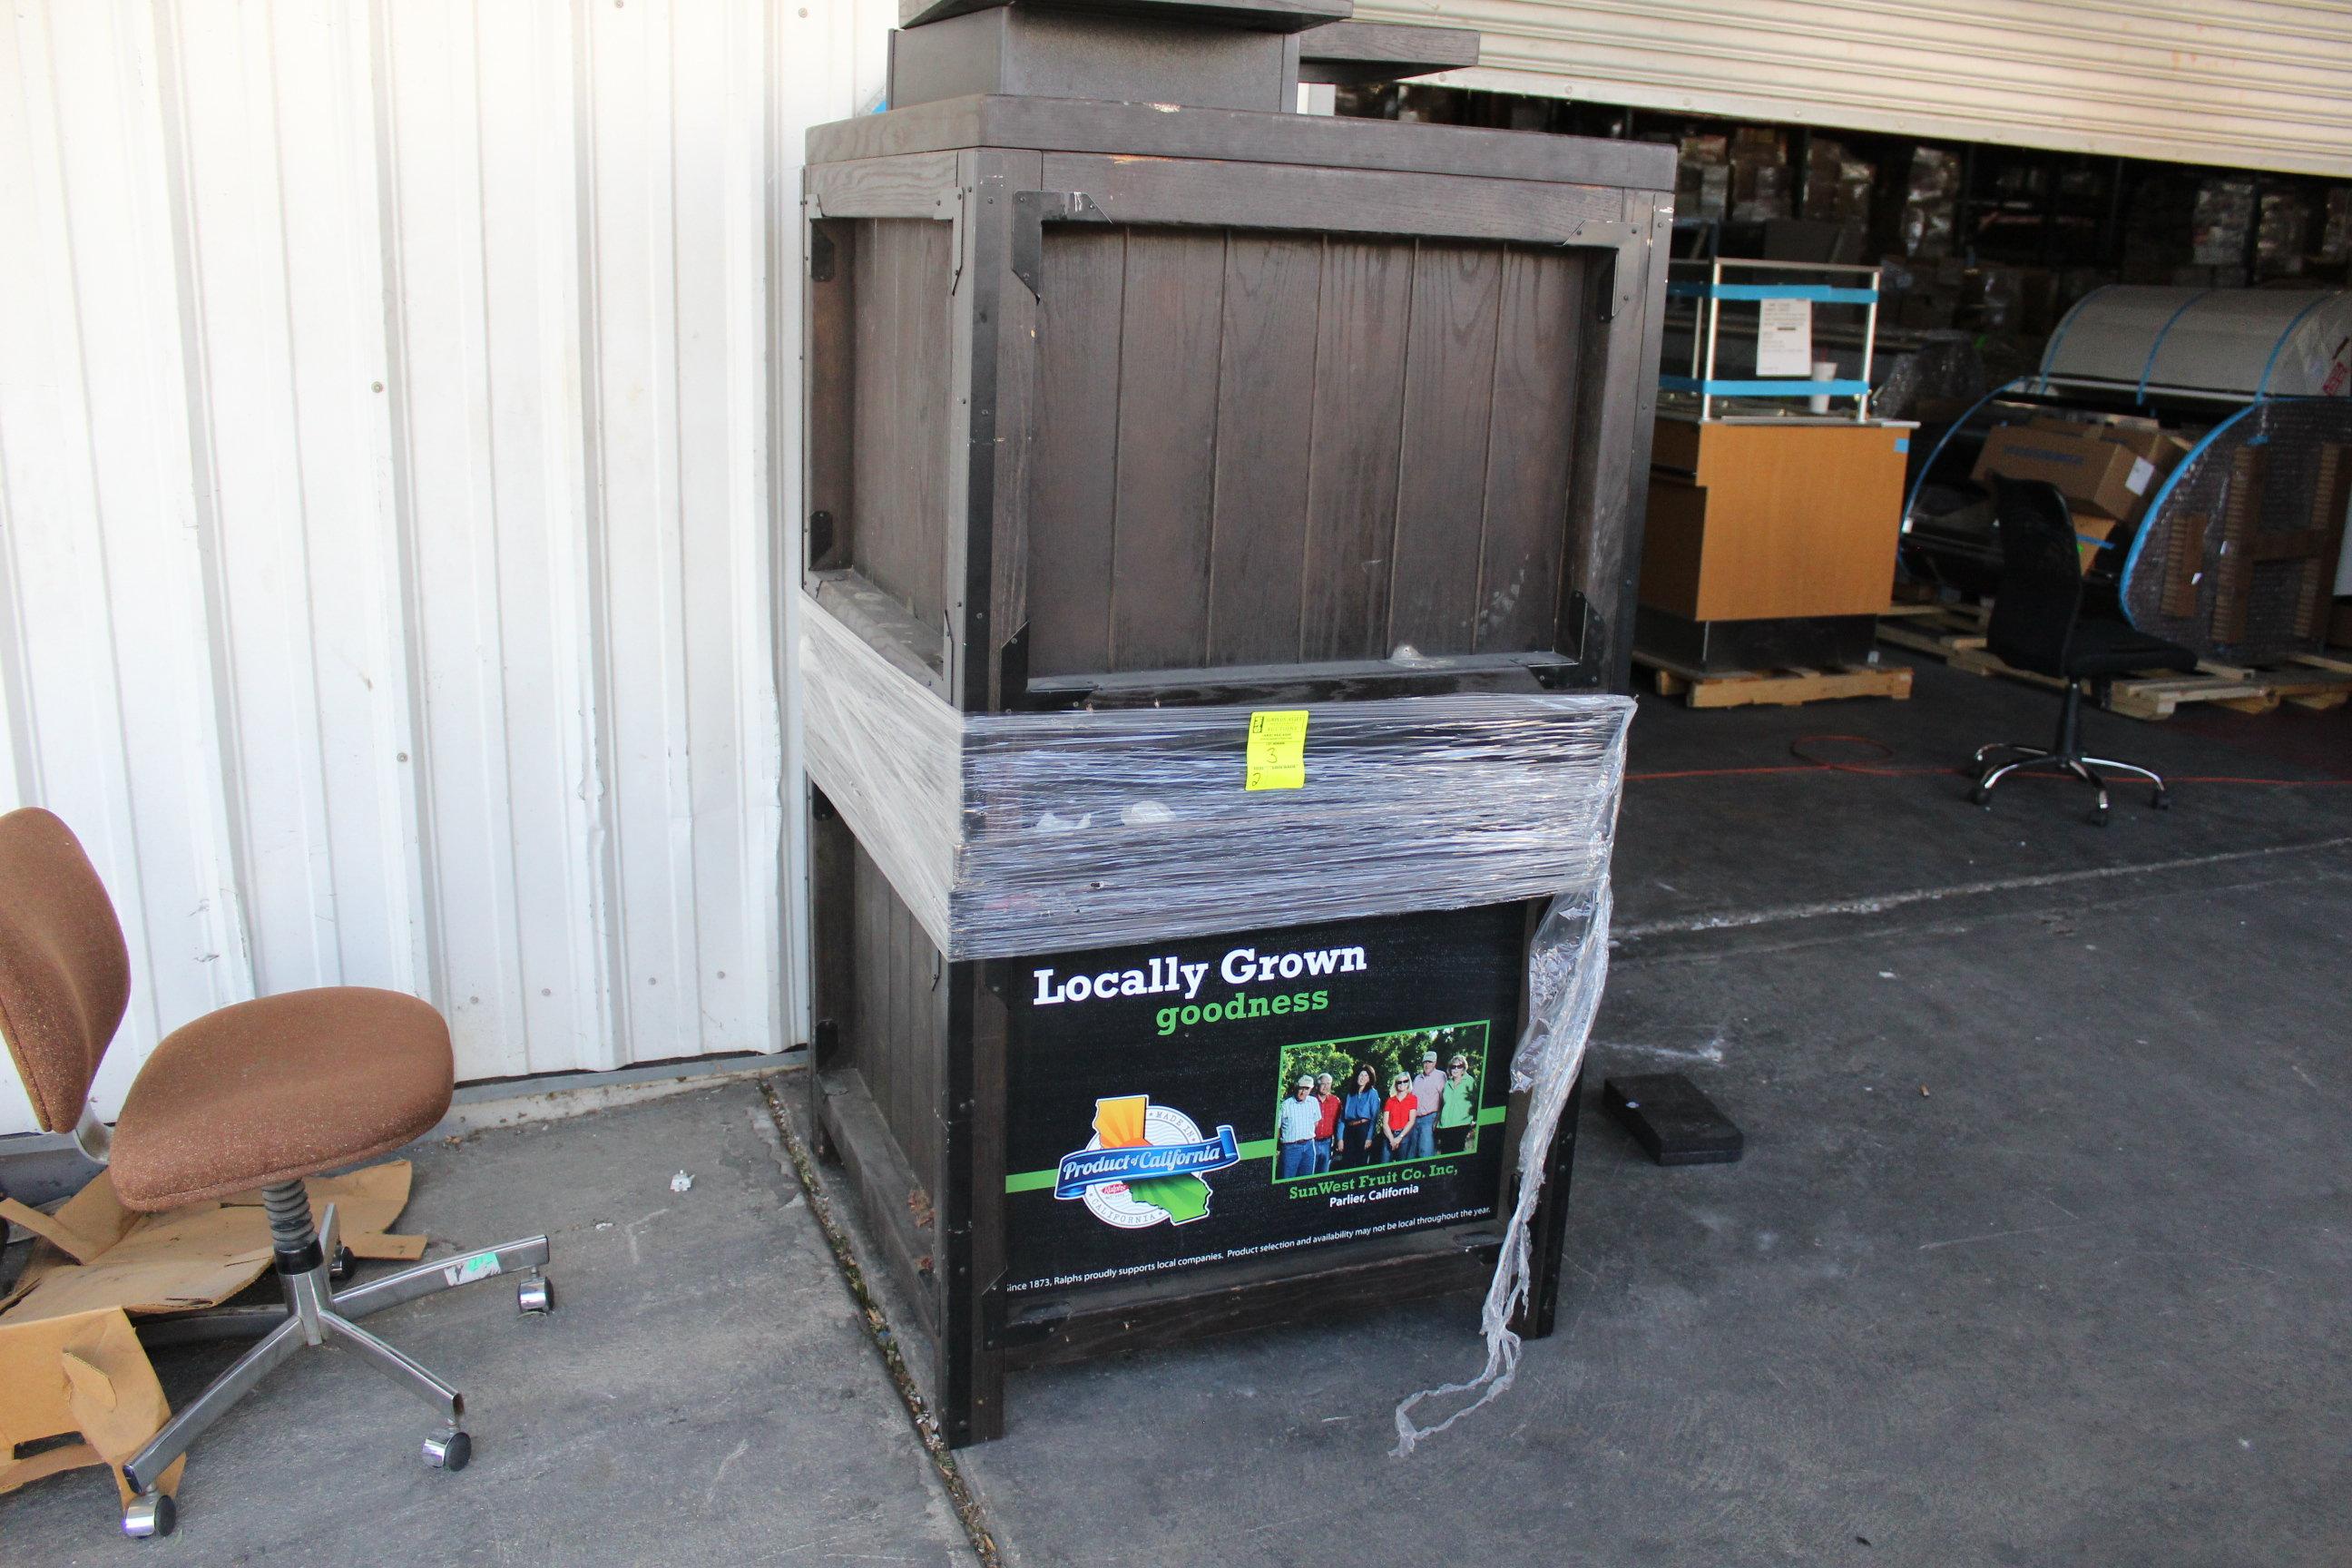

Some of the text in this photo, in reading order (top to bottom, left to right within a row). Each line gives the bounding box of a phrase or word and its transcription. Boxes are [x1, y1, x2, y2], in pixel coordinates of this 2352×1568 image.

[1266, 747, 1278, 763] 3
[1251, 772, 1261, 787] 2
[1033, 946, 1367, 1005] Locally Grown
[1156, 989, 1328, 1036] goodness
[1156, 1111, 1195, 1137] MADE IN
[1063, 1145, 1220, 1181] Product of California
[1289, 1179, 1356, 1200] SunWest
[1358, 1171, 1397, 1190] Fruit
[1401, 1168, 1426, 1181] Co.
[1329, 1184, 1419, 1208] Parlier, California
[1092, 1198, 1156, 1224] CALIFORNIA
[1029, 1279, 1053, 1289] 1873,
[1054, 1273, 1083, 1286] Ralphs
[1083, 1269, 1117, 1282] proudly
[1118, 1262, 1155, 1276] supports
[1157, 1259, 1176, 1269] local
[1178, 1252, 1224, 1266] companies.
[1227, 1246, 1259, 1258] Product
[1259, 1240, 1295, 1251] selection
[1296, 1237, 1311, 1246] and
[1312, 1230, 1354, 1243] availability
[1355, 1227, 1371, 1236] may
[1373, 1224, 1386, 1232] not
[1387, 1221, 1396, 1230] be
[1397, 1218, 1416, 1228] local
[1416, 1212, 1459, 1225] throughout
[1460, 1209, 1473, 1218] the
[1474, 1206, 1491, 1217] year.
